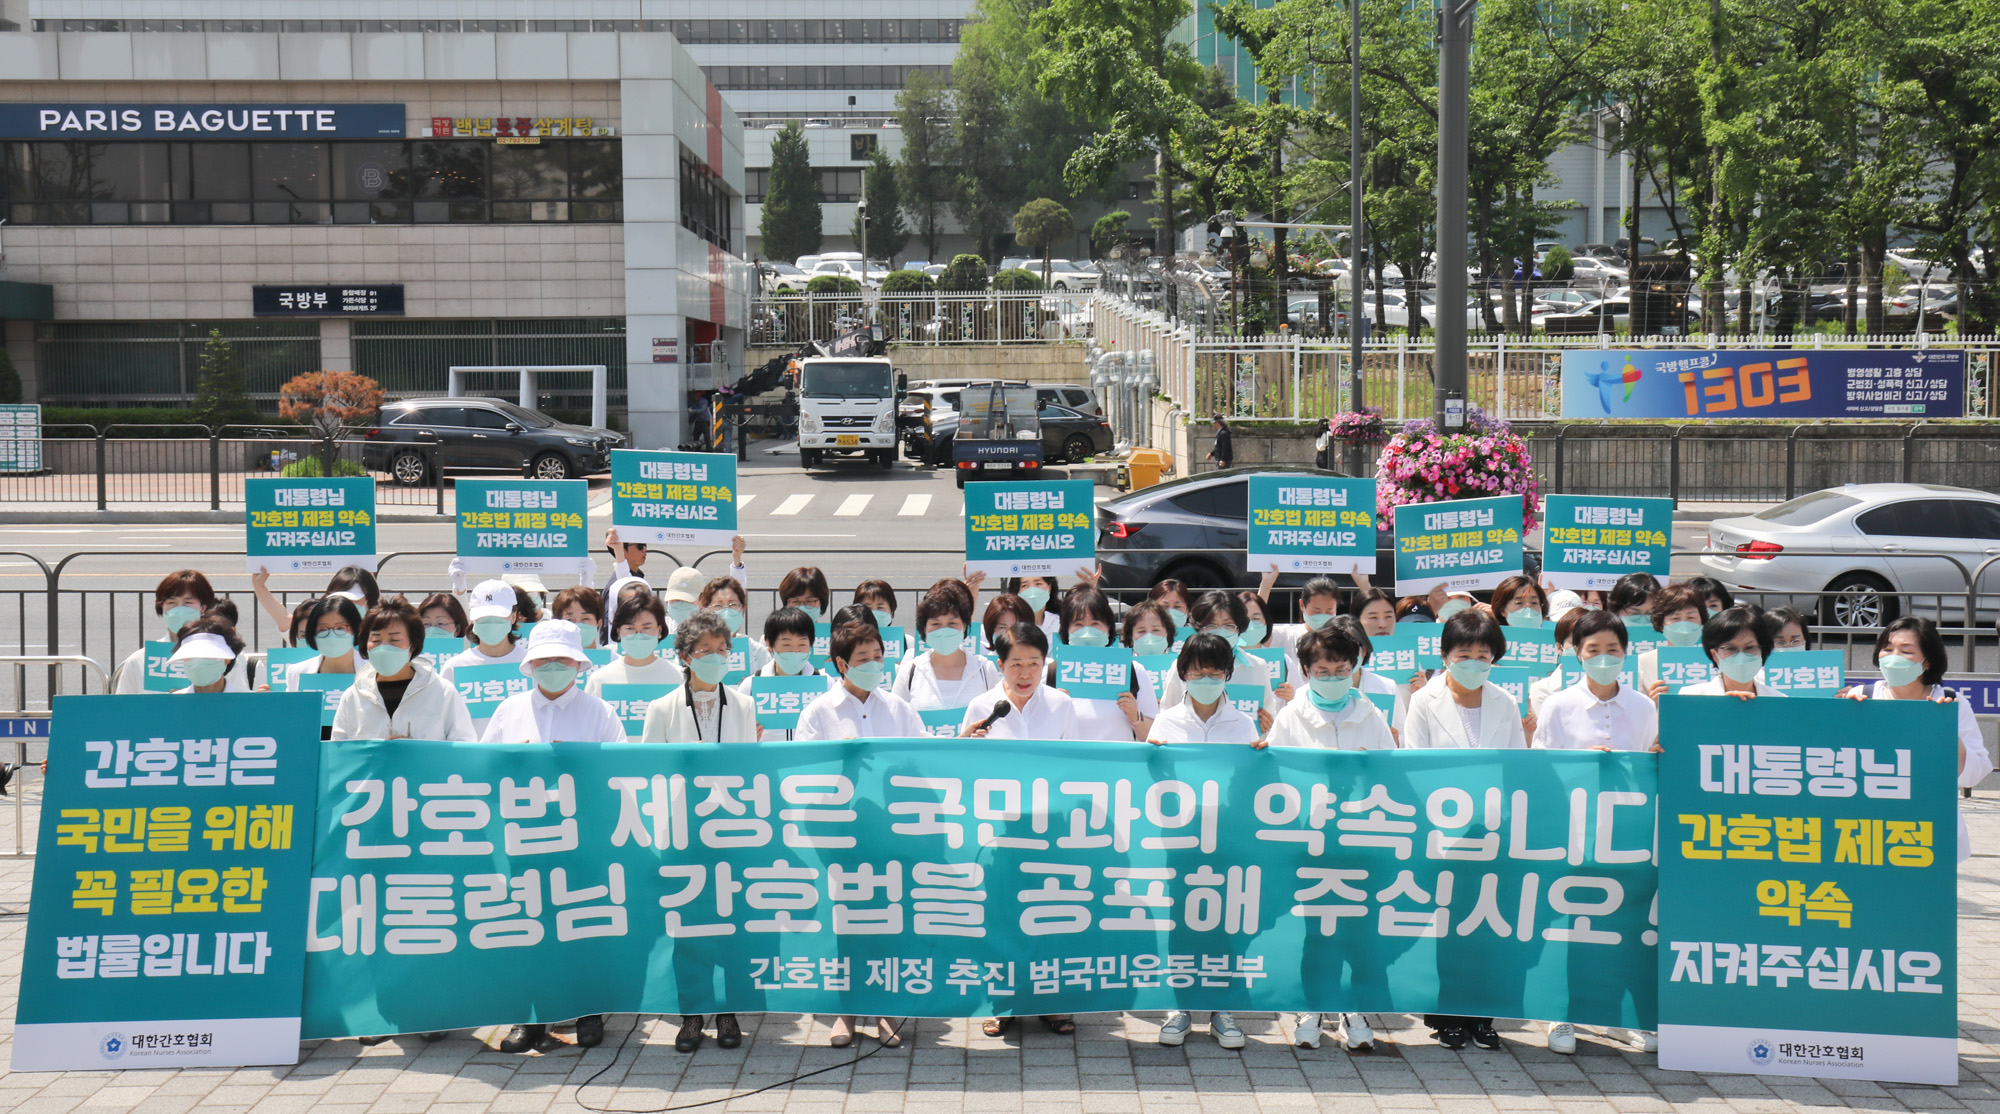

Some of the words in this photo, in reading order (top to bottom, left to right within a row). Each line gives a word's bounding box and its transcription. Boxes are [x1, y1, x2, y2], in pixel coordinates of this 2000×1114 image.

[39, 110, 142, 132] PARIS
[154, 110, 337, 132] BAGUETTE
[279, 292, 328, 309] 국방부
[1655, 355, 1711, 373] 국방헬프콜
[1847, 367, 1882, 378] 병영생활
[1884, 367, 1902, 378] 고충
[1904, 367, 1923, 378] 상담
[1678, 357, 1812, 416] 1303
[1905, 379, 1948, 390] 신고/상담
[1846, 390, 1902, 401] 방위사업비리
[1905, 390, 1948, 401] 신고/상담
[639, 461, 708, 481] 대통령님
[274, 488, 345, 507] 대통령님
[485, 490, 558, 509] 대통령님
[616, 482, 663, 499] 간호법
[666, 484, 698, 501] 제정
[701, 485, 733, 502] 약속
[993, 490, 1065, 510] 대통령님
[1277, 487, 1348, 507] 대통령님
[251, 510, 299, 527] 간호법
[301, 510, 335, 527] 제정
[337, 510, 371, 526] 약속
[461, 512, 510, 529] 간호법
[513, 512, 547, 529] 제정
[550, 512, 583, 529] 약속
[631, 502, 718, 520] 지켜주십시오
[1253, 508, 1301, 526] 간호법
[1304, 510, 1337, 527] 제정
[1340, 510, 1372, 528] 약속
[1423, 508, 1494, 531] 대통령님
[1574, 506, 1644, 526] 대통령님
[970, 513, 1018, 532] 간호법
[1021, 513, 1054, 531] 제정
[1057, 512, 1090, 530] 약속
[266, 530, 356, 547] 지켜주십시오
[476, 532, 568, 548] 지켜주십시오
[985, 533, 1075, 551] 지켜주십시오
[1267, 529, 1357, 547] 지켜주십시오
[1400, 533, 1448, 553] 간호법
[1450, 530, 1483, 548] 제정
[1486, 527, 1518, 545] 약속
[1549, 527, 1597, 545] 간호법
[1599, 529, 1632, 546] 제정
[1635, 530, 1667, 547] 약속
[1415, 548, 1504, 570] 지켜주십시오
[1562, 548, 1651, 566] 지켜주십시오
[1060, 661, 1126, 686] 간호법
[1769, 666, 1840, 690] 간호법
[459, 677, 529, 704] 간호법
[84, 736, 278, 788] 간호법은
[1698, 743, 1912, 801] 대통령님
[340, 773, 579, 860] 간호법
[608, 772, 858, 850] 제정은
[887, 773, 1220, 855] 국민과의
[1253, 782, 1659, 865] 약속입니다
[56, 806, 192, 854] 국민을
[202, 804, 293, 851] 위해
[1677, 812, 1822, 864] 간호법
[1834, 817, 1935, 868] 제정
[72, 869, 118, 917] 꼭
[129, 866, 268, 914] 필요한
[306, 862, 629, 956] 대통령님
[658, 859, 988, 938] 간호법을
[1017, 860, 1263, 937] 공포해
[1290, 865, 1659, 946] 주십시오!
[1755, 878, 1854, 929] 약속
[56, 931, 272, 980] 법률입니다
[748, 956, 851, 991] 간호법
[865, 956, 934, 994] 제정
[945, 956, 1016, 996] 추진
[1029, 954, 1268, 994] 범국민운동본부
[1670, 940, 1944, 995] 지켜주십시오
[132, 1032, 213, 1049] 대한간호협회
[1779, 1043, 1864, 1060] 대한간호협회
[1826, 1060, 1864, 1068] Association
